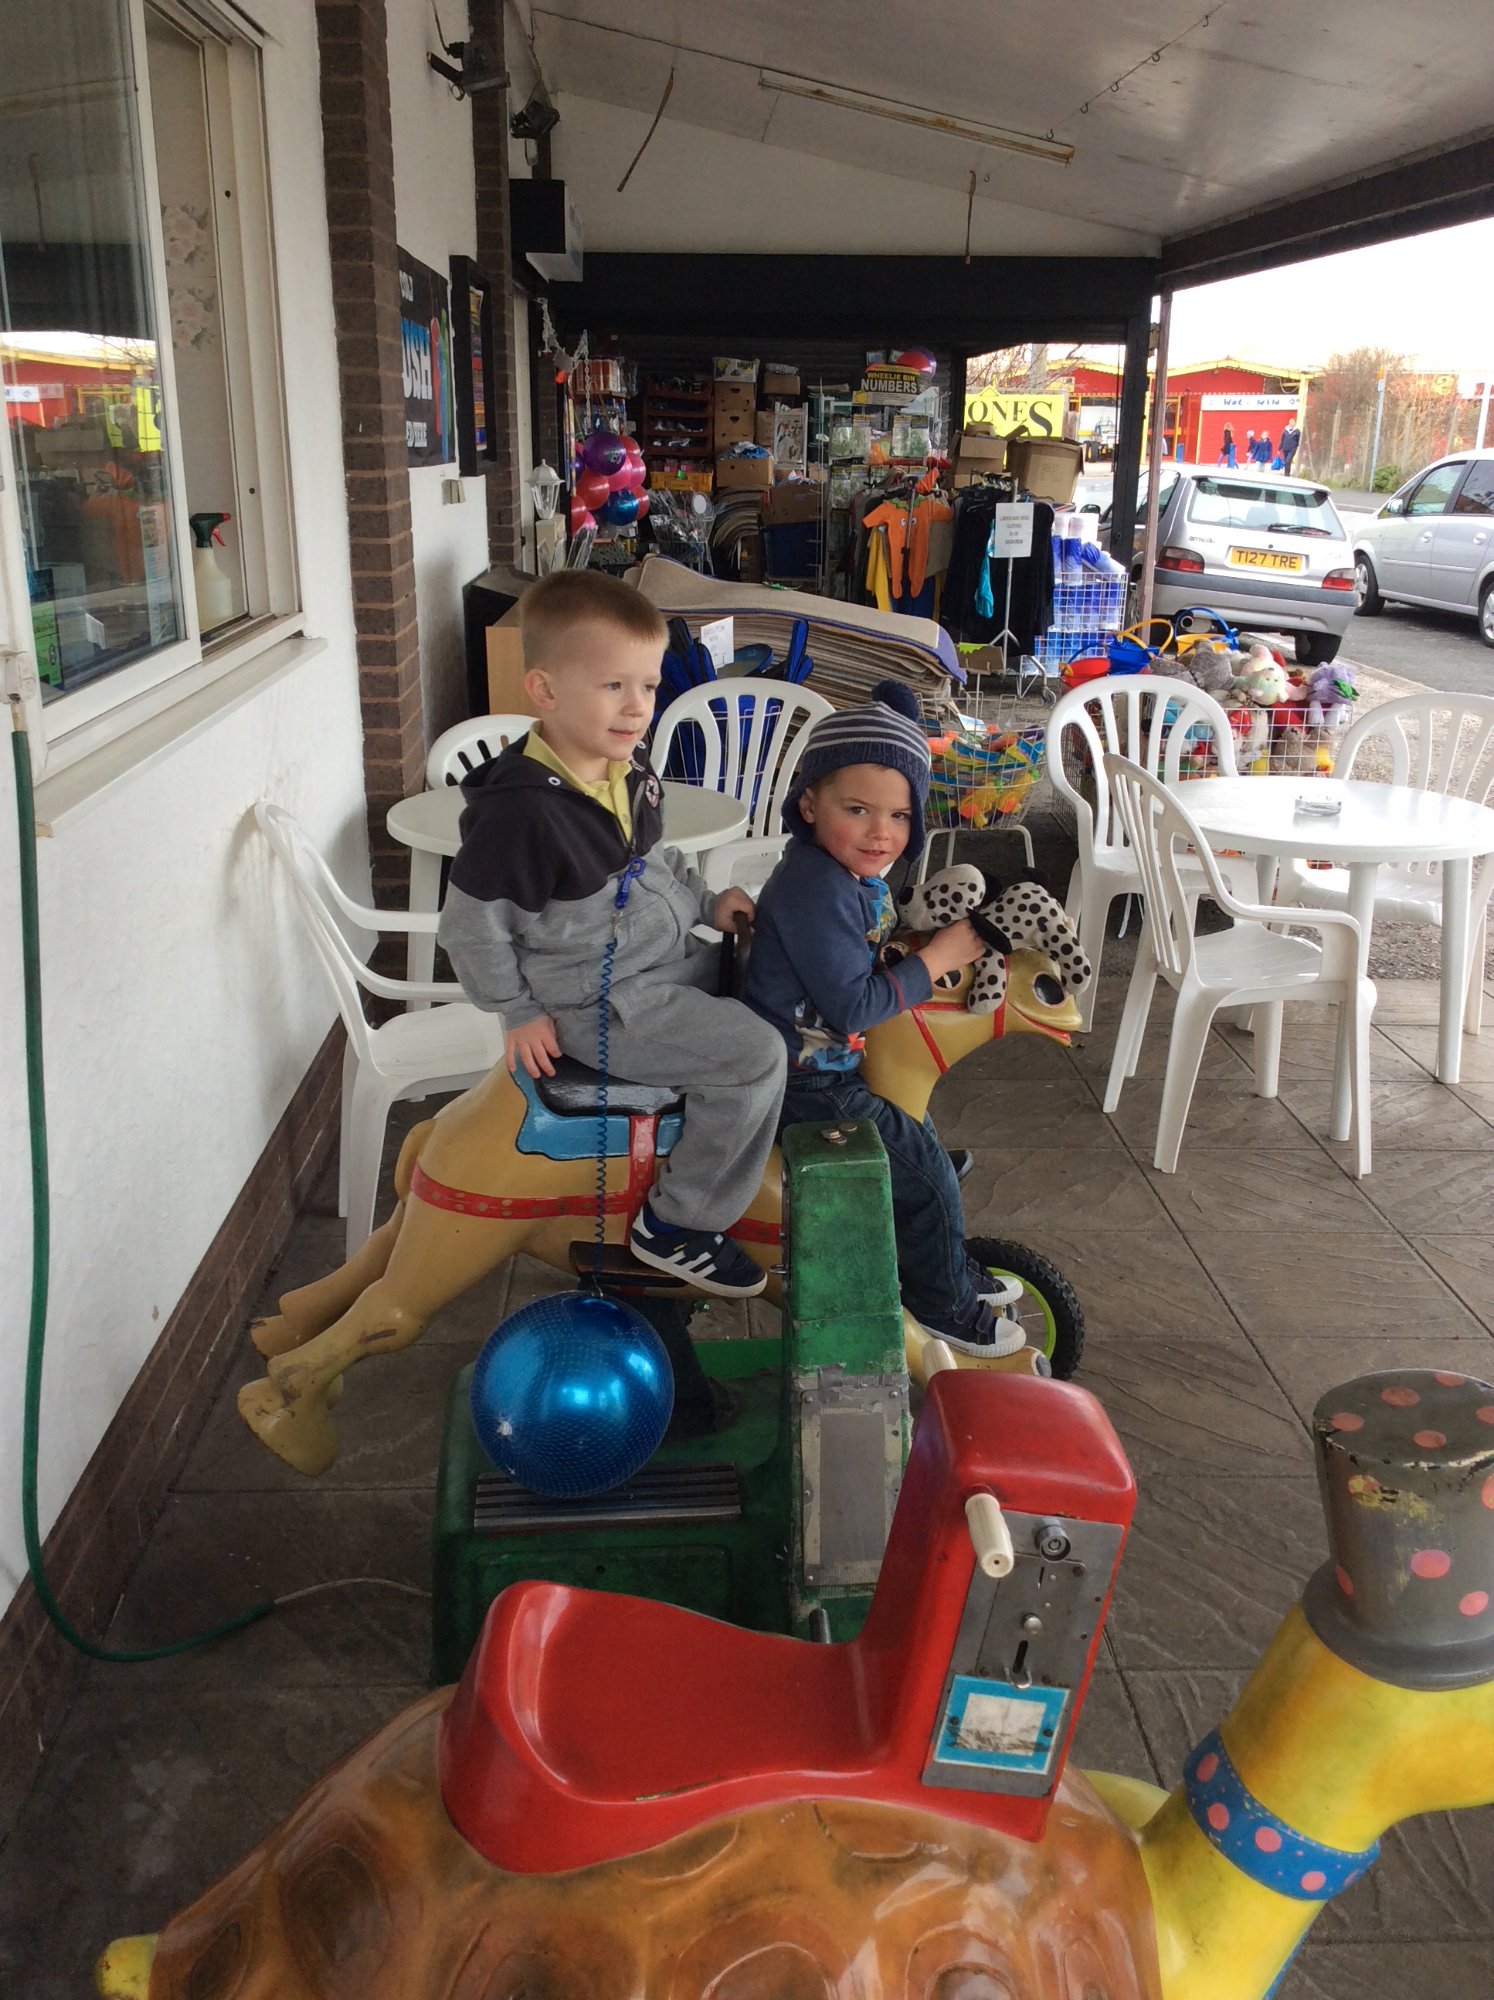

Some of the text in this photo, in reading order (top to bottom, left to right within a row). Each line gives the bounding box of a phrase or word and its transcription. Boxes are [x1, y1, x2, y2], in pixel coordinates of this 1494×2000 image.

[861, 378, 917, 393] NUMBERS
[966, 400, 1053, 437] ONES
[1236, 550, 1298, 569] T127 TRE
